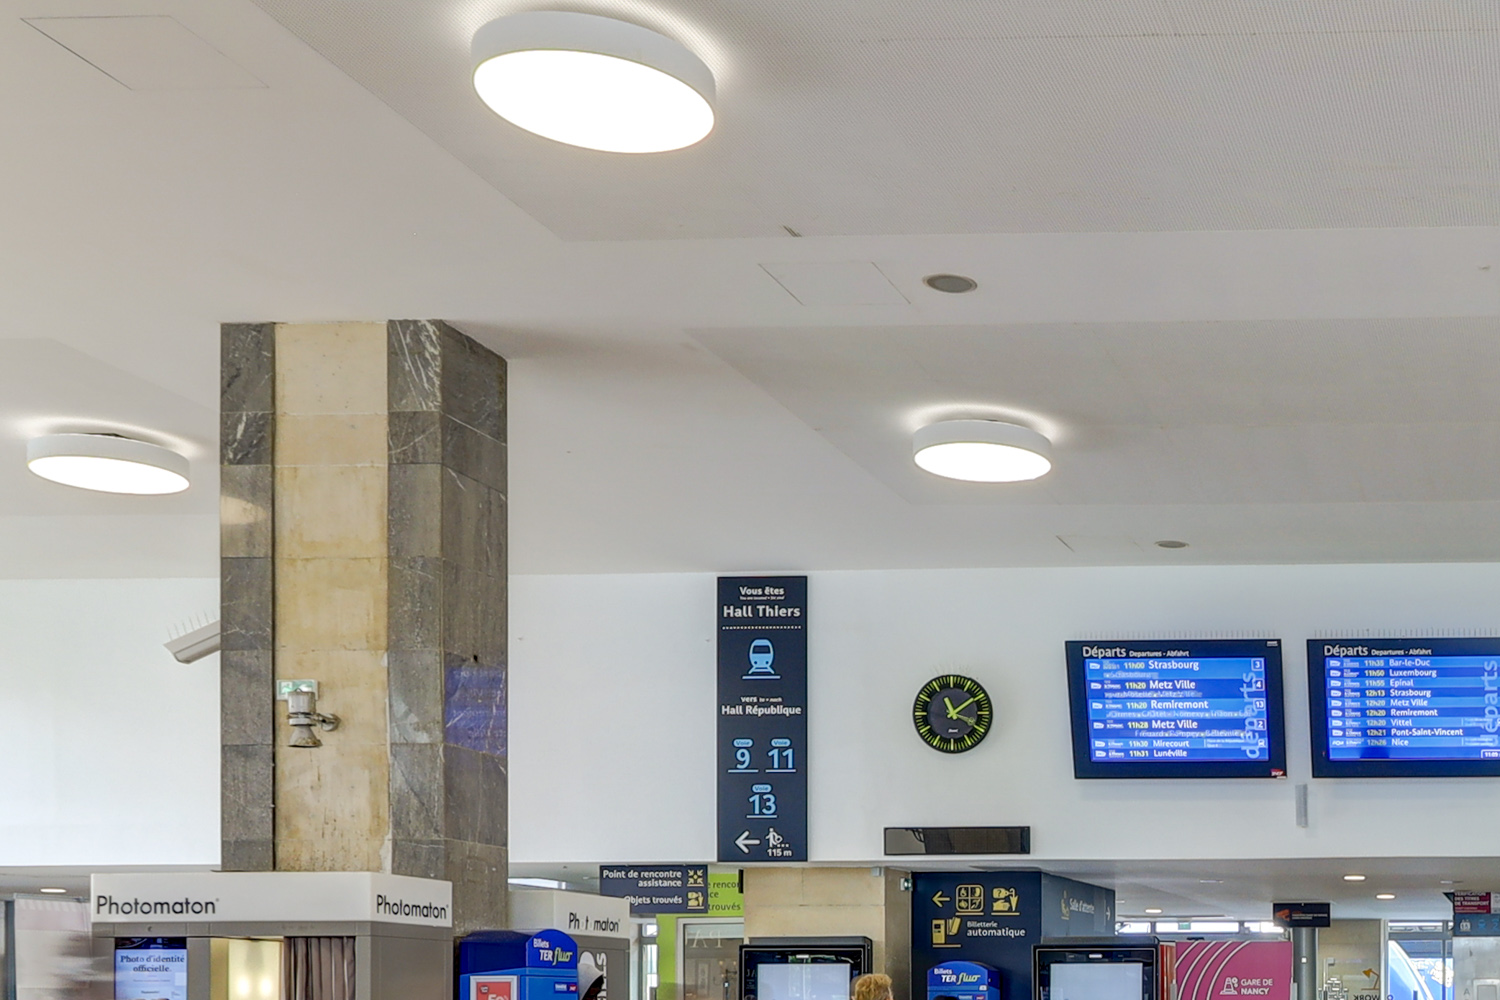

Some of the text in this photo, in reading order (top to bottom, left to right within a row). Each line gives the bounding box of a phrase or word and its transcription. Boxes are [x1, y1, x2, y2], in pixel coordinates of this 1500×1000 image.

[740, 587, 784, 595] Vous êtes
[723, 606, 801, 618] Hall Thiers
[1082, 646, 1126, 658] Départs
[1129, 650, 1162, 658] Departures
[1324, 645, 1368, 657] Départs
[1148, 661, 1199, 671] Strasbourg
[1389, 669, 1437, 678] Luxembourg
[1150, 680, 1172, 689] Metz
[1174, 680, 1196, 689] Ville
[1390, 689, 1431, 698] Strasbourg
[1151, 700, 1209, 709] Remiremont
[722, 705, 802, 717] Hall République
[1152, 720, 1175, 729] Metz
[1176, 720, 1198, 729] Ville
[1153, 749, 1187, 757] Lunéville
[736, 749, 794, 769] 9 11
[749, 794, 776, 815] 13
[767, 849, 782, 857] 115
[603, 870, 626, 879] Point
[628, 870, 639, 878] de
[652, 895, 682, 904] trouvés
[96, 895, 216, 915] Photomaton
[377, 895, 447, 920] Photomaton
[967, 928, 1026, 938] automatique
[533, 938, 549, 948] Billets
[121, 954, 185, 963] Photo d'identité
[540, 950, 553, 961] TER
[941, 975, 957, 983] TER
